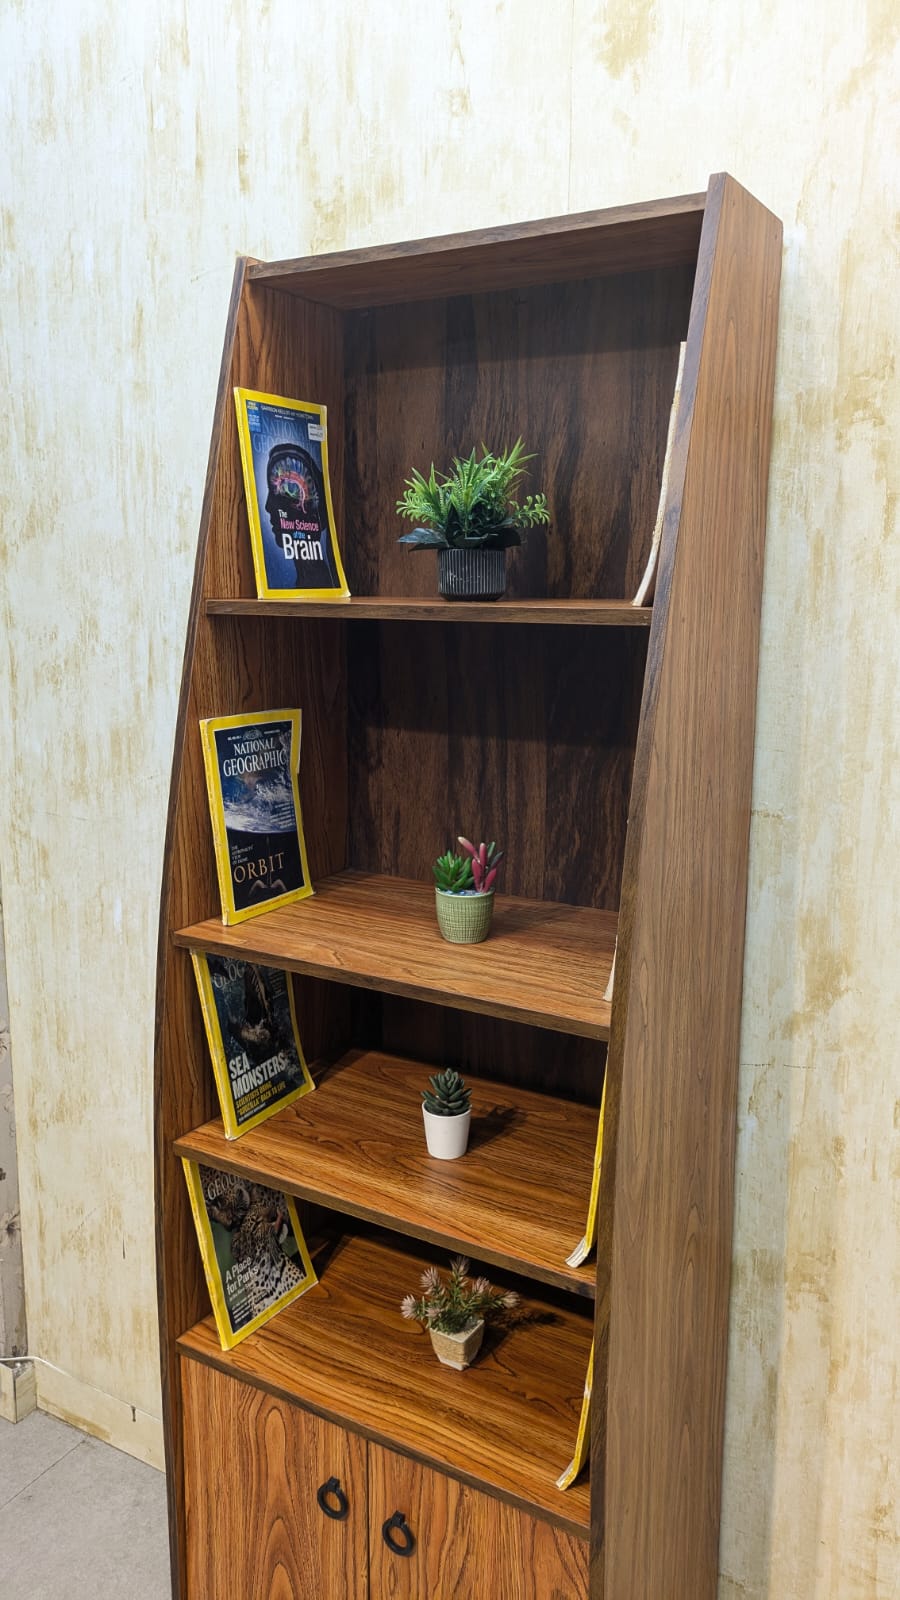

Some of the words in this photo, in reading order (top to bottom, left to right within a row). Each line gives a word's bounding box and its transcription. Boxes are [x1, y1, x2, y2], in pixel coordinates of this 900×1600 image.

[278, 509, 288, 518] The
[280, 518, 295, 530] New
[295, 520, 319, 531] Science
[282, 533, 323, 560] Brain
[233, 737, 276, 756] NATIONAL
[223, 749, 287, 777] GEOGRAPHIC
[233, 852, 284, 883] ORBIT
[228, 1051, 251, 1080] SEA
[226, 1270, 232, 1283] A
[231, 1256, 252, 1278] Place
[227, 1281, 238, 1296] for
[237, 1265, 259, 1287] Parks
